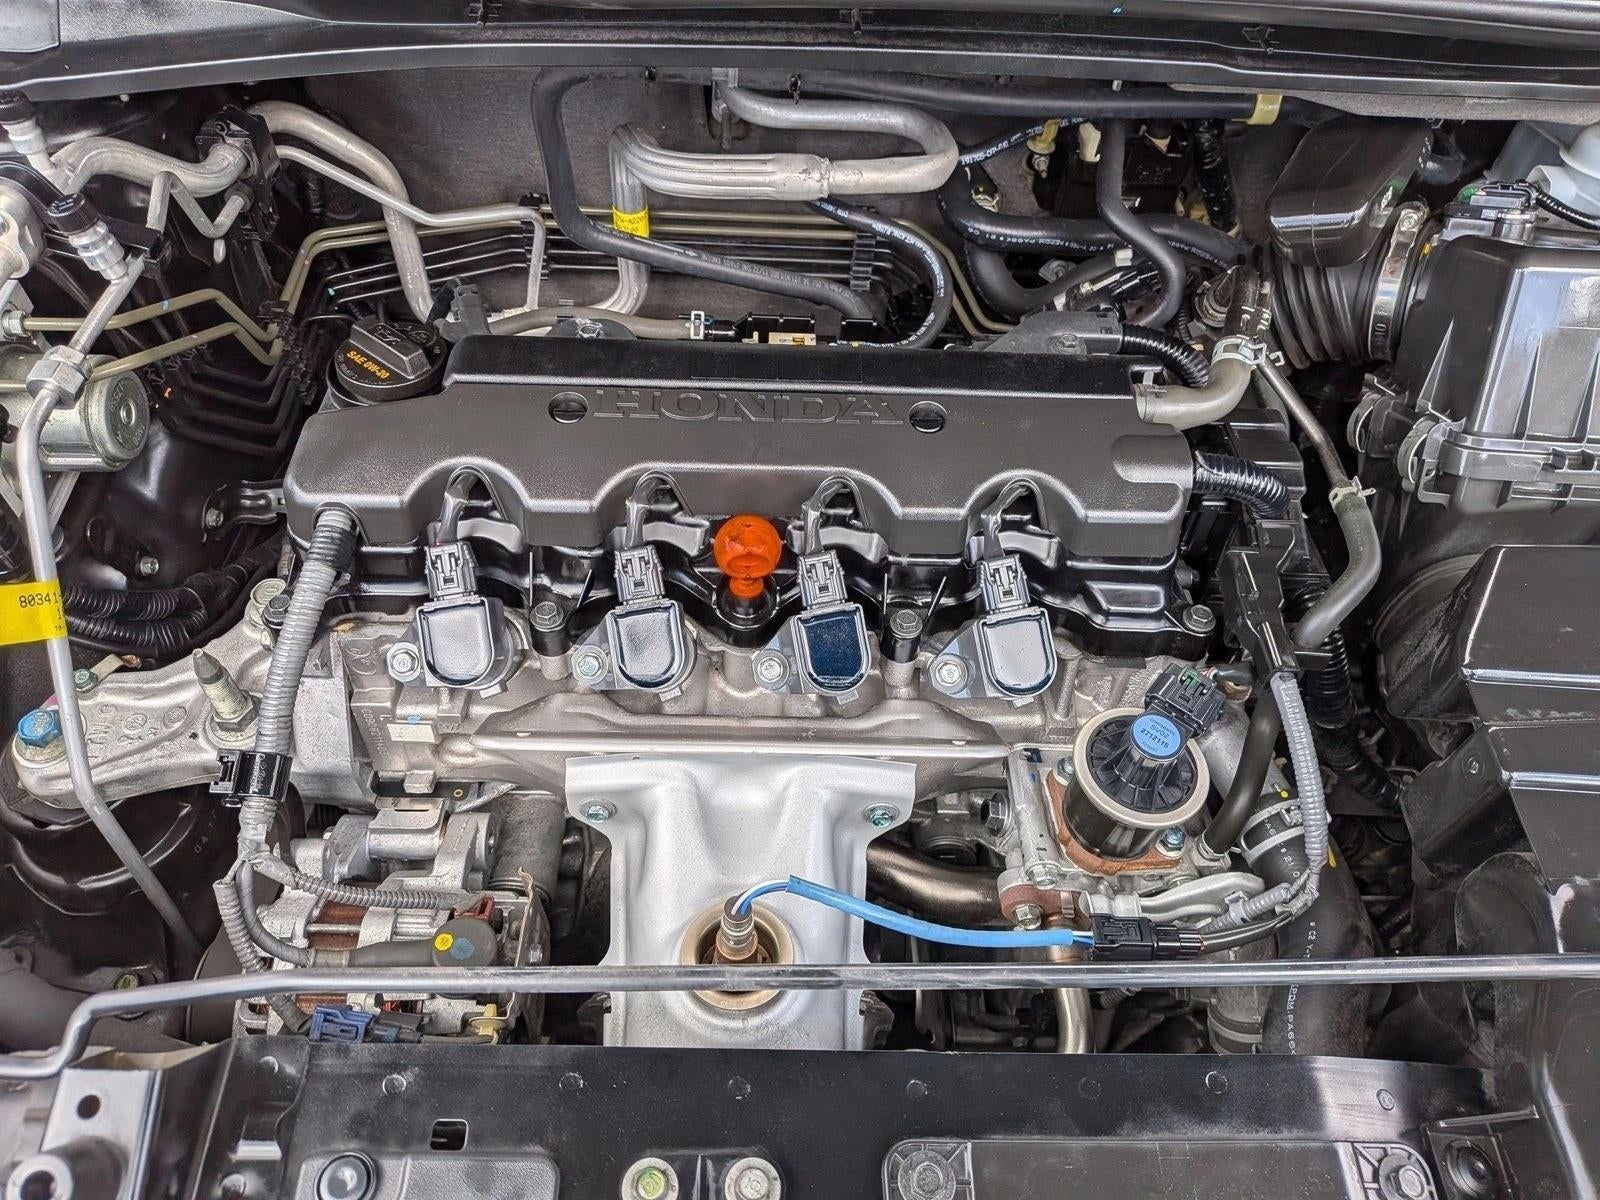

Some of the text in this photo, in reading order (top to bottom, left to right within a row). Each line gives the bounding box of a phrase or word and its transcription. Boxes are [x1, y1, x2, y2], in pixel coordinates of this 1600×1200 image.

[346, 350, 367, 365] SAE
[363, 361, 390, 379] 0W-20
[594, 389, 904, 424] HONDA
